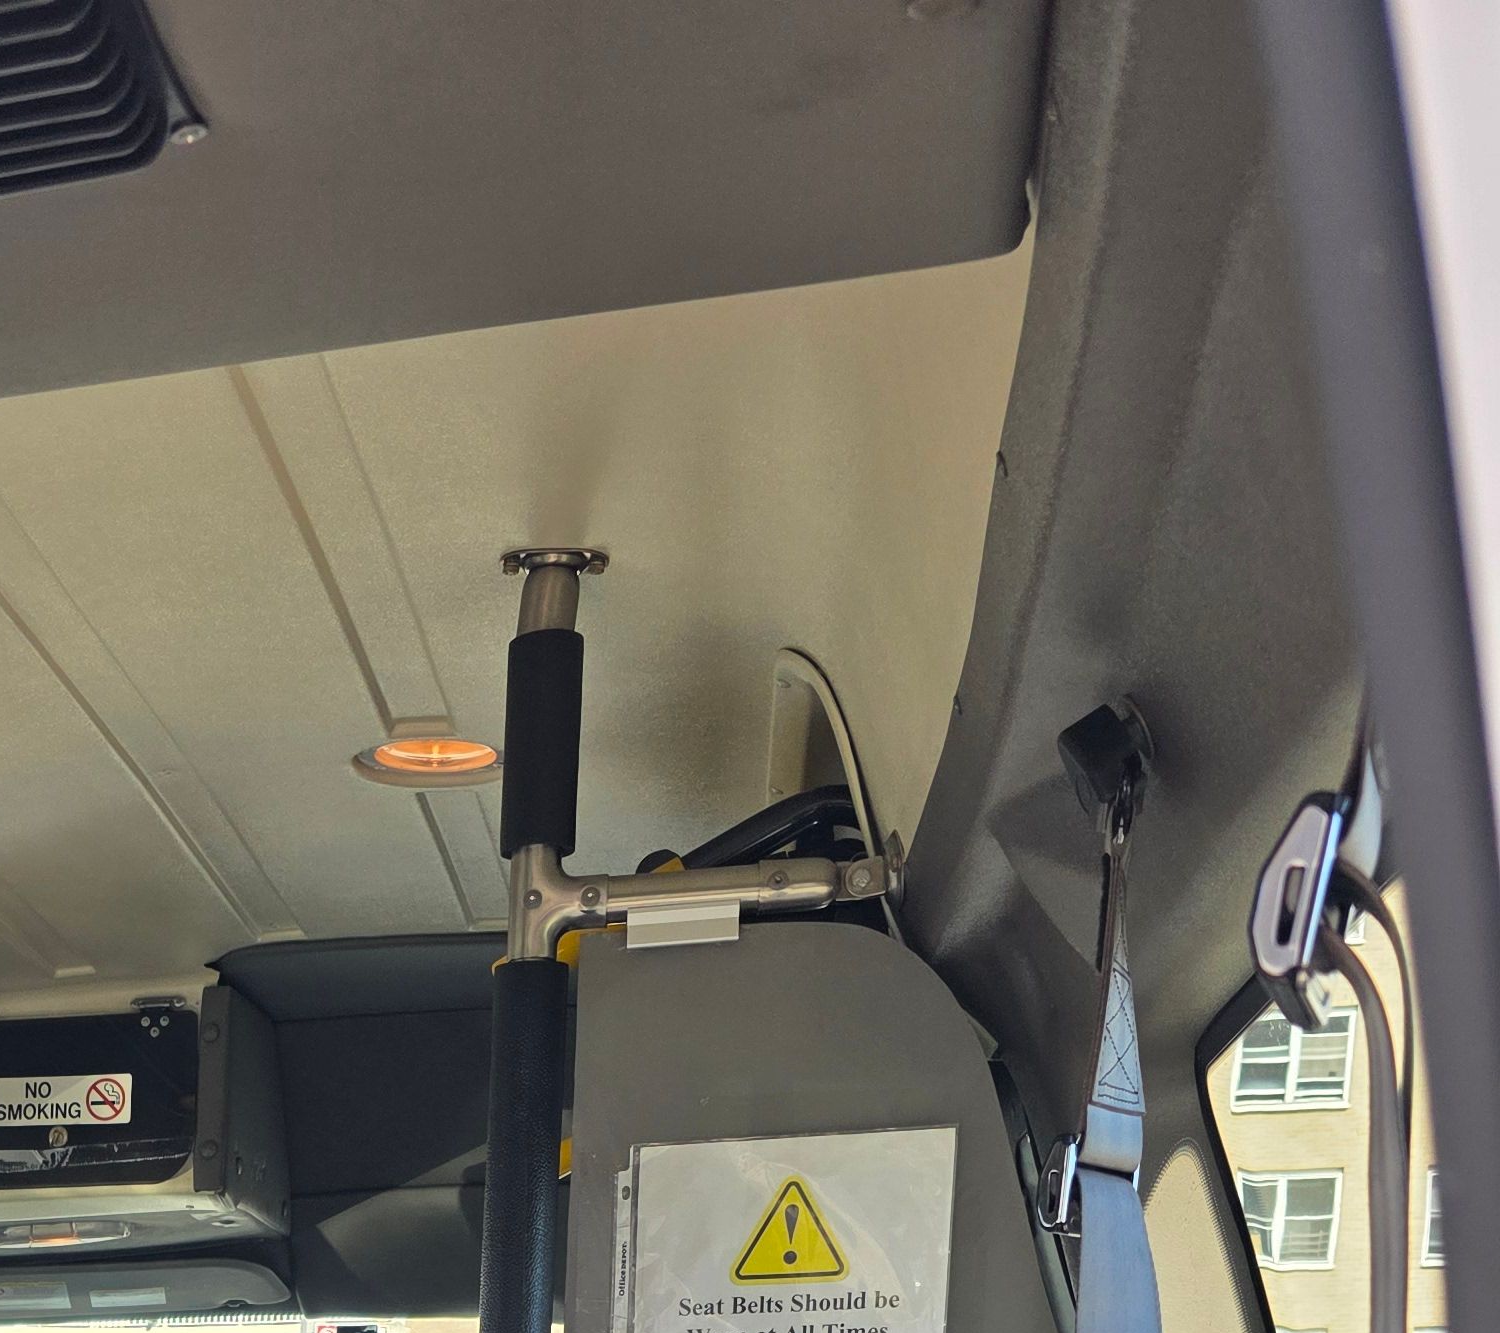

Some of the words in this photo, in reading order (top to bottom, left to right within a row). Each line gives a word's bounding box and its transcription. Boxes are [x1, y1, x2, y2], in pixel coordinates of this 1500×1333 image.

[25, 1081, 52, 1099] NO
[678, 1297, 725, 1317] Seat
[732, 1296, 784, 1315] Belts
[790, 1291, 867, 1313] Should
[875, 1290, 901, 1309] be
